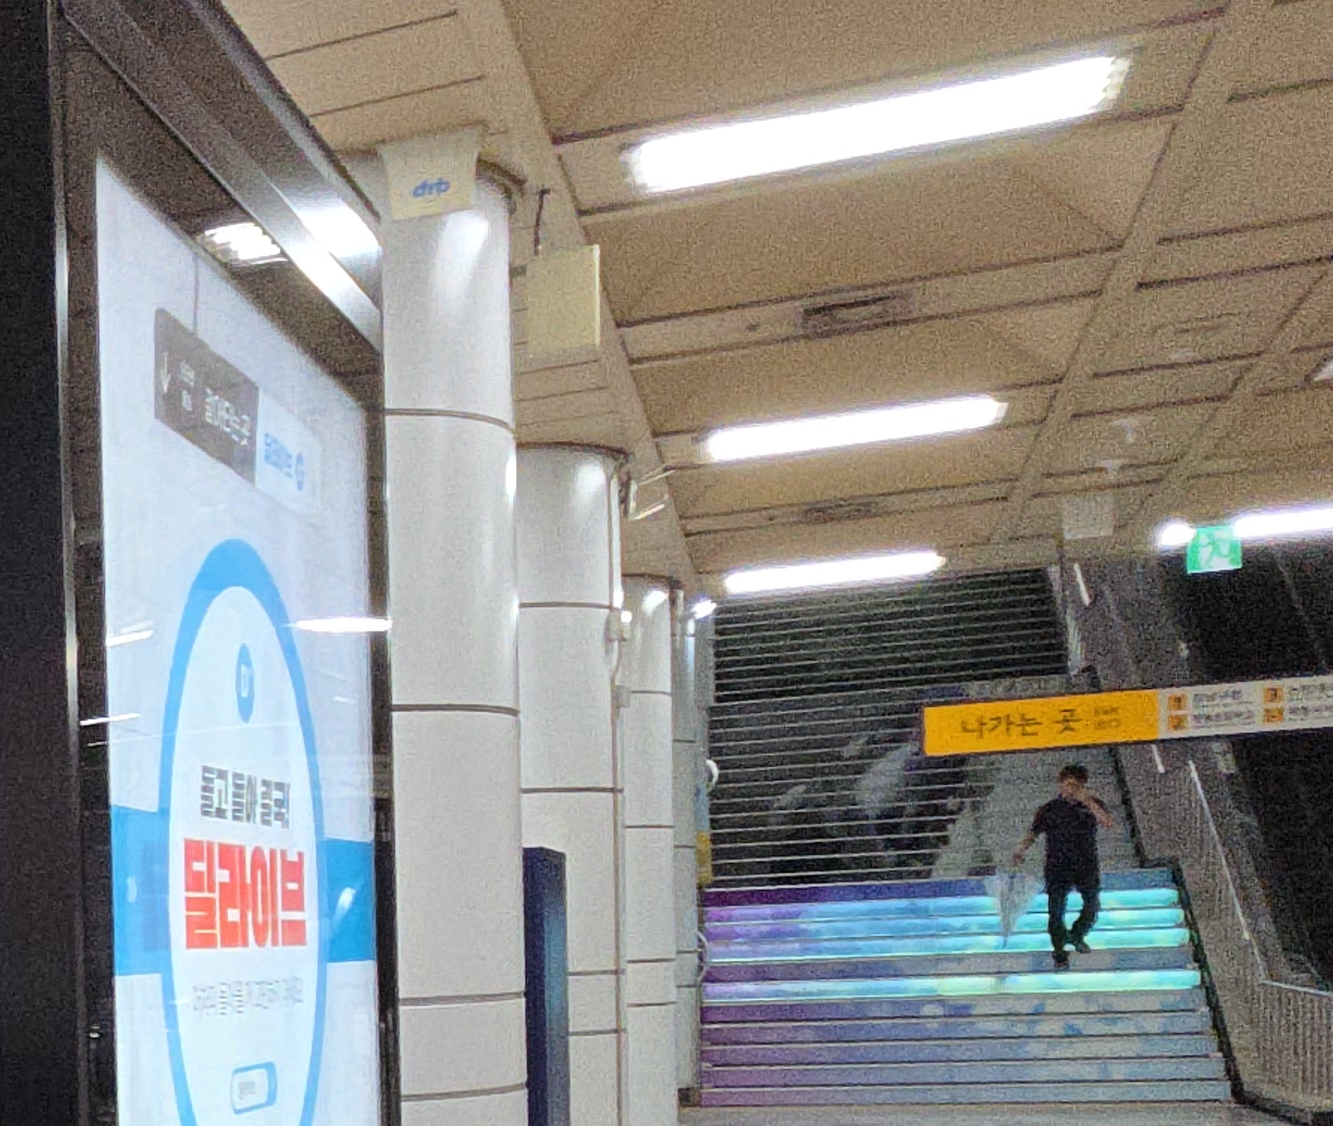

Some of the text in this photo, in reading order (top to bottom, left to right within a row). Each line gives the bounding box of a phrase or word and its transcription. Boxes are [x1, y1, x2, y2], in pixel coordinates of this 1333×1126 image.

[960, 713, 1042, 739] 나가는
[1052, 708, 1082, 734] 곳
[183, 837, 307, 949] 딜라이브
